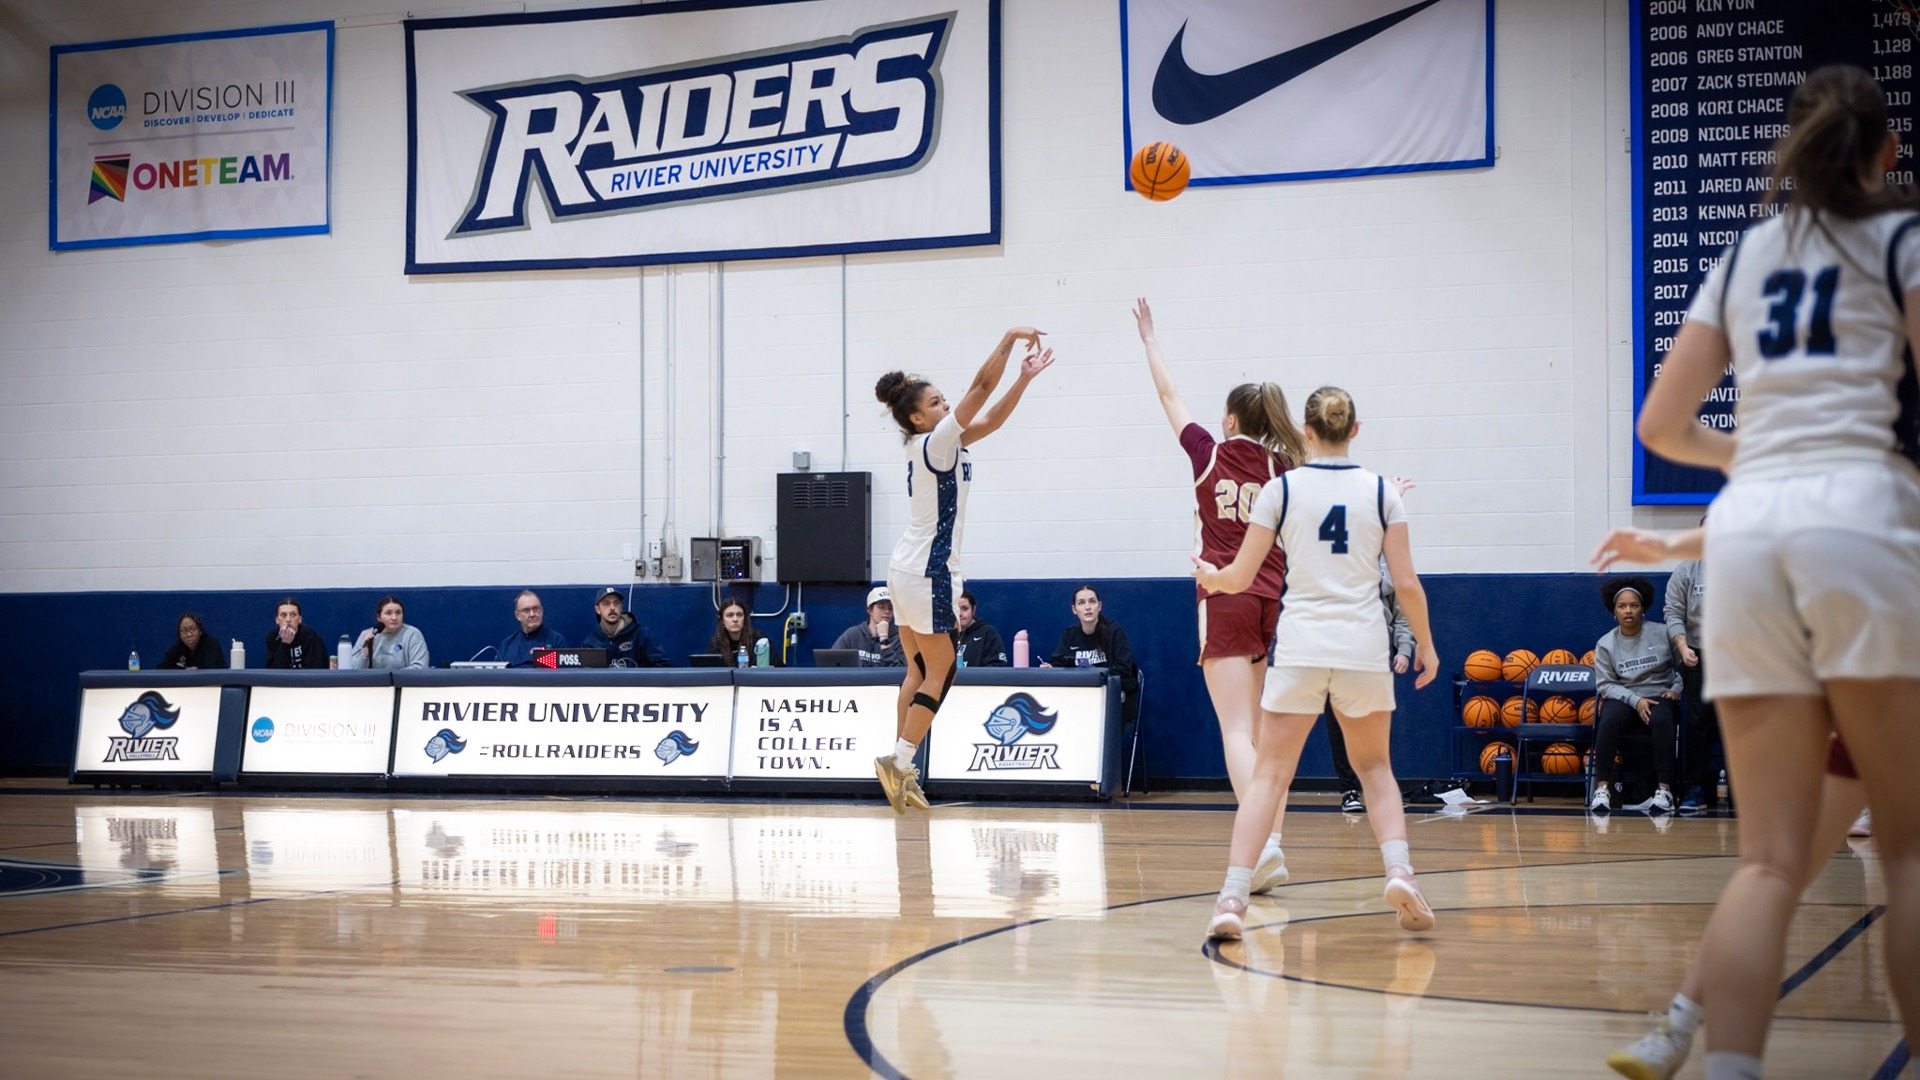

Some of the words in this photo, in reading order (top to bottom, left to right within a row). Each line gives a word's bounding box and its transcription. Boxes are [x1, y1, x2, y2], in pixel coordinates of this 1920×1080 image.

[1650, 0, 1687, 15] 2004
[1696, 0, 1722, 12] KIN
[1650, 25, 1687, 41] 2006
[1696, 22, 1734, 39] ANDY
[1738, 20, 1785, 36] CHACE
[1872, 12, 1911, 28] 1,479
[1650, 51, 1688, 67] 2006
[1697, 48, 1735, 65] GREG
[1738, 45, 1803, 62] STANTON
[1872, 38, 1912, 55] 1,128
[1651, 77, 1688, 93] 2007
[1697, 74, 1734, 90] ZACK
[1737, 71, 1807, 89] STEDMAN
[1872, 64, 1913, 82] 1,188
[143, 82, 263, 115] DIVISION
[275, 80, 295, 104] III
[91, 105, 126, 120] NCAA
[1651, 103, 1689, 119] 2008
[1697, 100, 1734, 116] KORI
[1738, 97, 1784, 114] CHACE
[143, 116, 191, 128] DISCOVER
[196, 112, 241, 123] DEVELOP
[248, 108, 295, 120] DEDICATE
[476, 32, 936, 222] RAIDERS
[1651, 130, 1689, 144] 2009
[1698, 126, 1750, 142] NICOLE
[1753, 124, 1791, 139] HERS
[611, 164, 682, 192] RIVIER
[690, 143, 823, 181] UNIVERSITY
[1652, 154, 1688, 170] 2010
[1698, 151, 1737, 168] MATT
[133, 152, 290, 191] ONETEAM
[1653, 180, 1687, 196] 2011
[1698, 177, 1742, 193] JARED
[1653, 207, 1688, 222] 2013
[1698, 203, 1746, 220] KENNA
[1653, 232, 1688, 248] 2014
[1653, 258, 1688, 274] 2015
[1654, 284, 1688, 300] 2017
[1654, 310, 1688, 326] 2017
[1759, 267, 1840, 359] 31
[1215, 479, 1262, 523] 20
[1318, 505, 1348, 554] 4
[559, 654, 581, 666] POSS.
[1537, 671, 1590, 684] RIVIER
[422, 702, 518, 722] RIVIER
[528, 703, 709, 723] UNIVERSITY
[760, 699, 859, 713] NASHUA
[253, 729, 273, 737] NCAA
[285, 723, 357, 737] DIVISION
[364, 723, 376, 737] III
[760, 718, 780, 732] IS
[789, 718, 803, 732] A
[104, 737, 178, 762] RIVIER
[758, 737, 857, 751] COLLEGE
[757, 756, 831, 770] TOWN.
[968, 744, 1060, 770] RIVIER
